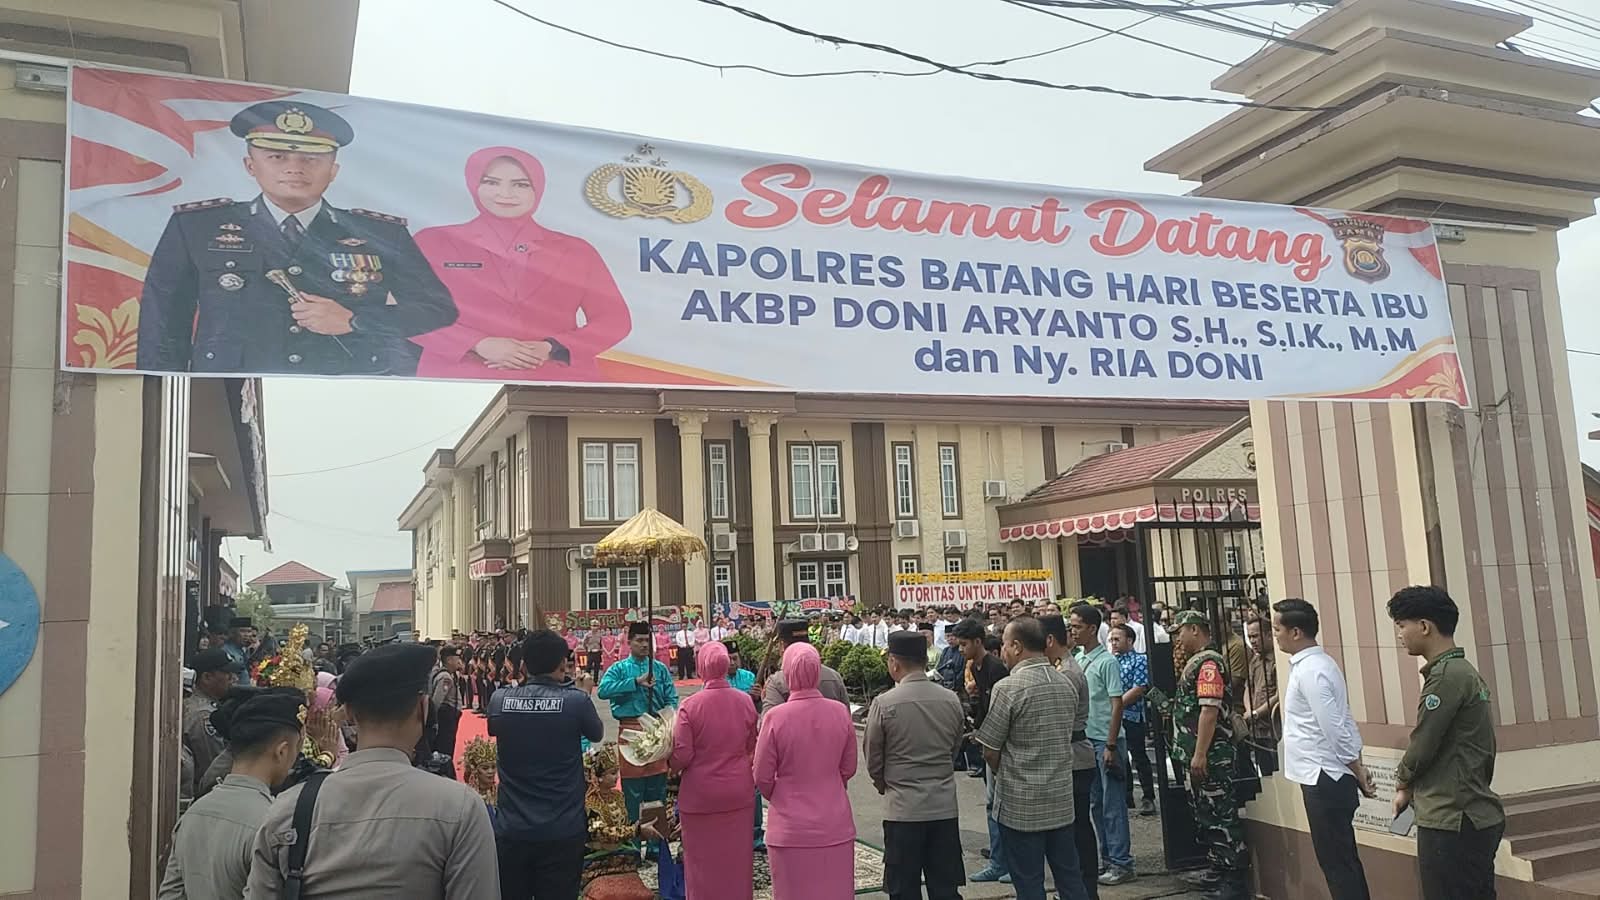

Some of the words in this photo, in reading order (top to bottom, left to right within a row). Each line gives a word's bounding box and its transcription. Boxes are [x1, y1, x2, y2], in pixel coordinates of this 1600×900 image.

[725, 163, 1070, 243] Selamat
[1084, 199, 1331, 281] Datang
[639, 237, 906, 288] KAPOLRES
[921, 258, 1093, 299] BATANG
[1107, 271, 1201, 306] HARI
[1212, 280, 1366, 318] BESERTA
[1373, 292, 1428, 320] IBU
[681, 289, 817, 327] AKBP
[833, 297, 948, 333] DONI
[961, 305, 1158, 342] ARYANTO
[1350, 325, 1417, 358] M.M
[914, 340, 999, 374] dan
[1013, 344, 1078, 385] Ny.
[1090, 348, 1157, 379] RIA
[1168, 353, 1265, 382] DONI
[1181, 487, 1248, 502] POLRES
[900, 585, 955, 603] OTORITAS
[958, 584, 995, 601] UNTUK
[998, 582, 1050, 600] MELAYANI
[504, 699, 534, 711] HUMAS
[535, 699, 561, 711] POLRI
